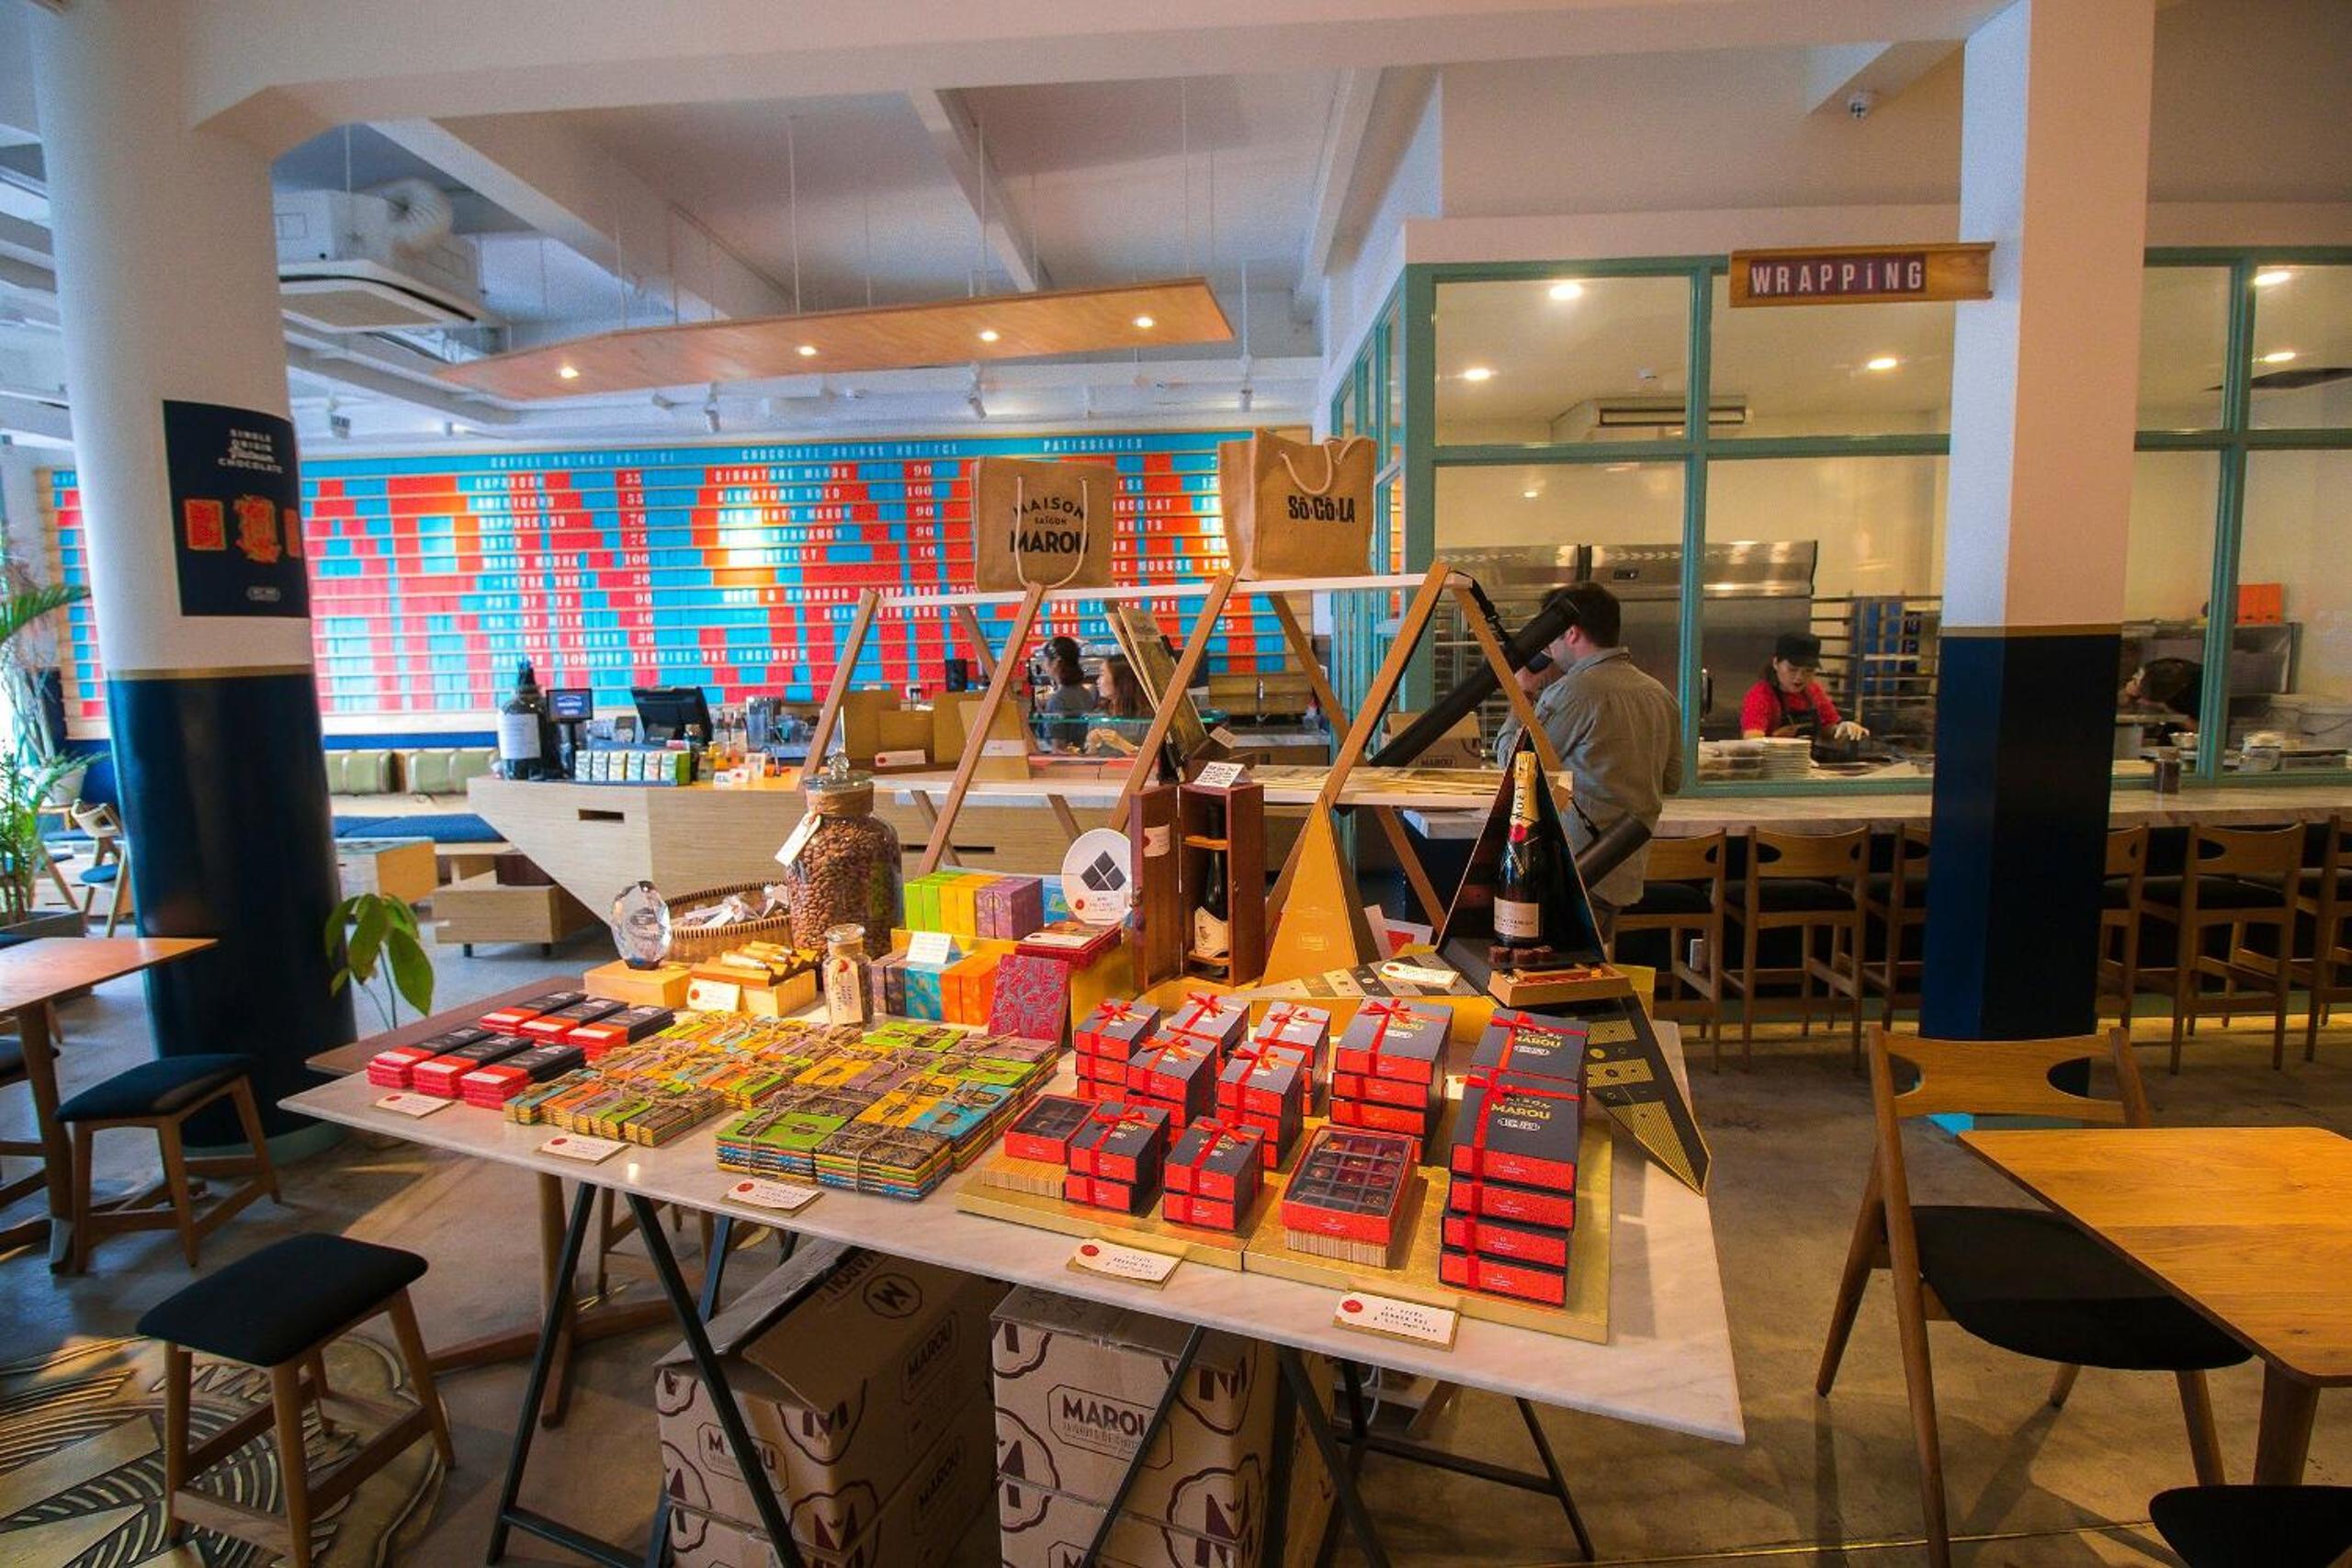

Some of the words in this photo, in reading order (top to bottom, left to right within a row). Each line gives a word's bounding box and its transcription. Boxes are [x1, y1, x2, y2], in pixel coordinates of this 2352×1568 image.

[1043, 438, 1143, 453] PATISSERIES
[741, 448, 820, 461] CHOCOLATE
[218, 457, 284, 474] CHOCOLATE
[715, 468, 794, 482] SIGNATURE
[912, 464, 932, 477] 90
[717, 488, 794, 502] SIGNATURE
[906, 484, 932, 497] 100
[623, 553, 650, 565] 100
[1490, 1102, 1552, 1121] MAROU
